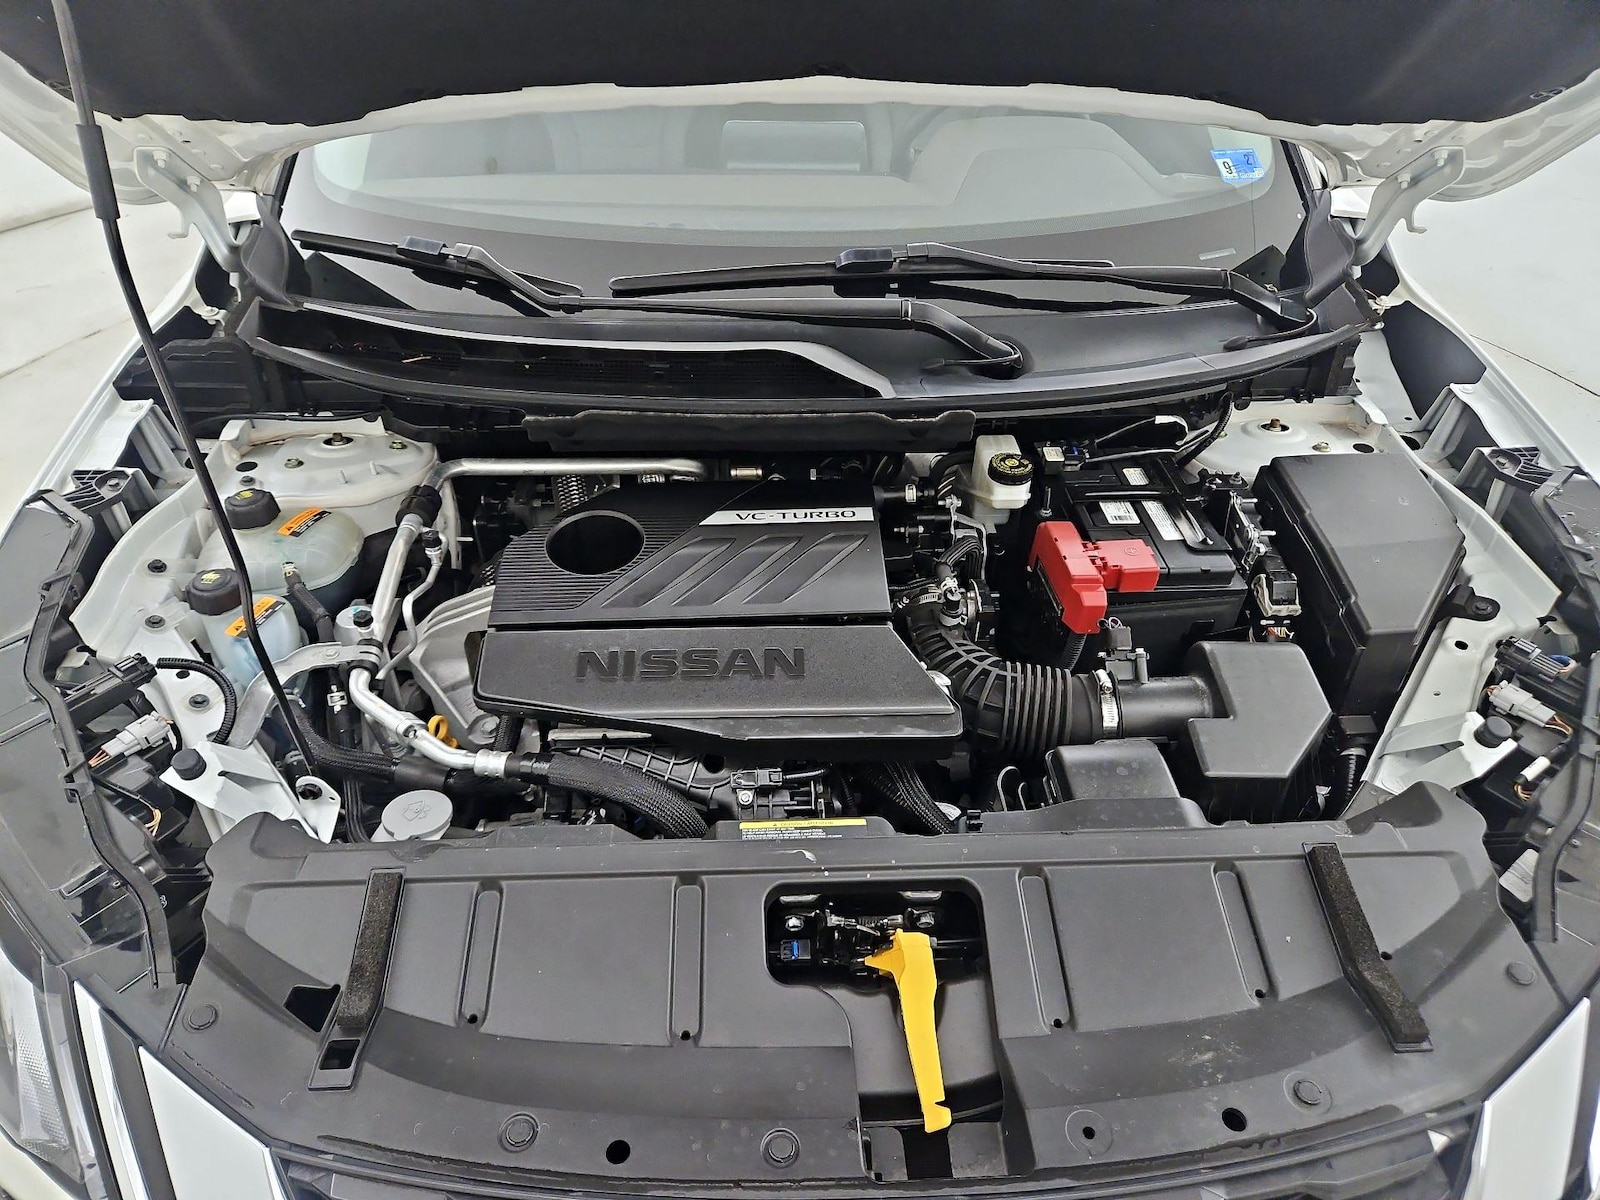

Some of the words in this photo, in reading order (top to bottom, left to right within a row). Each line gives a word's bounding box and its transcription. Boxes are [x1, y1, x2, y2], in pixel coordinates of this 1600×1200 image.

[1222, 160, 1233, 175] 9
[735, 510, 856, 521] VC-TURBO
[576, 646, 806, 681] NISSAN
